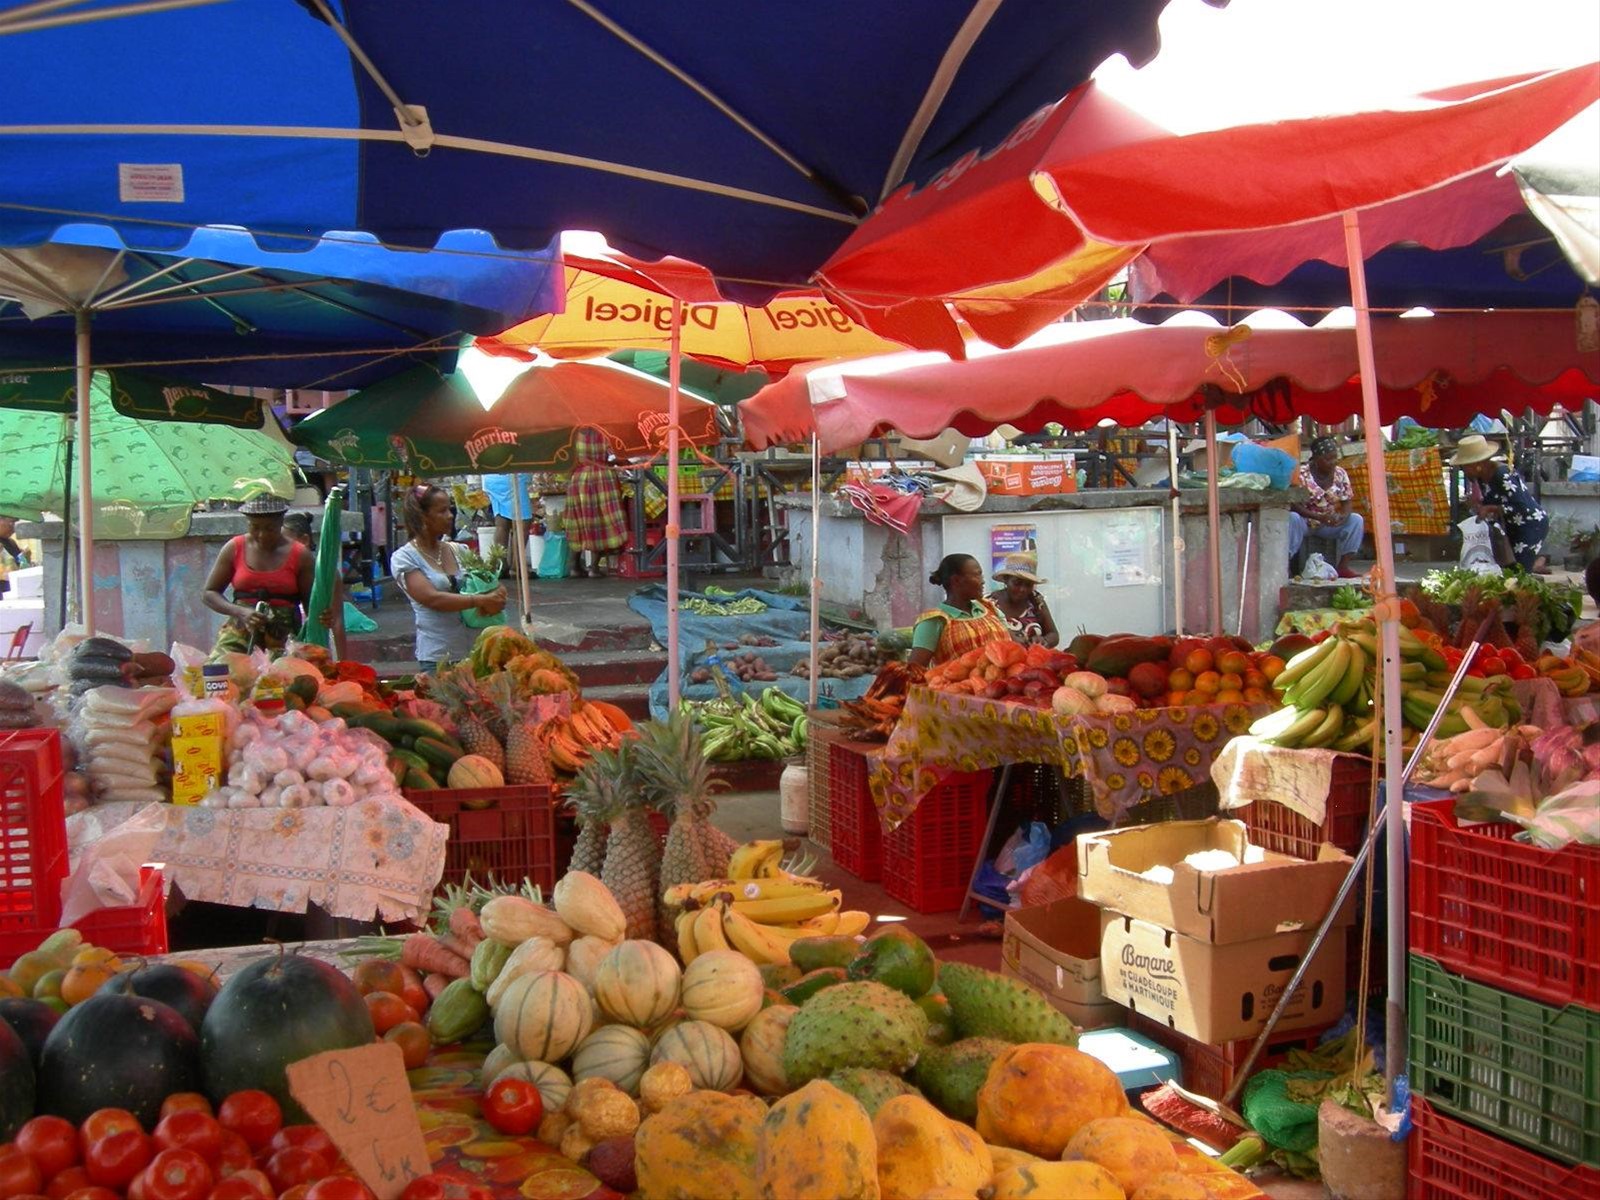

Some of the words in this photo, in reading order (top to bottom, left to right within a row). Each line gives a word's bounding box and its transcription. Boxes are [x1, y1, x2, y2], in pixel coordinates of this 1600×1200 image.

[464, 429, 518, 469] Perrier
[1121, 944, 1178, 980] Banane
[1127, 970, 1178, 1000] GUADELOUPE
[1128, 981, 1175, 1011] MARTINIQUE
